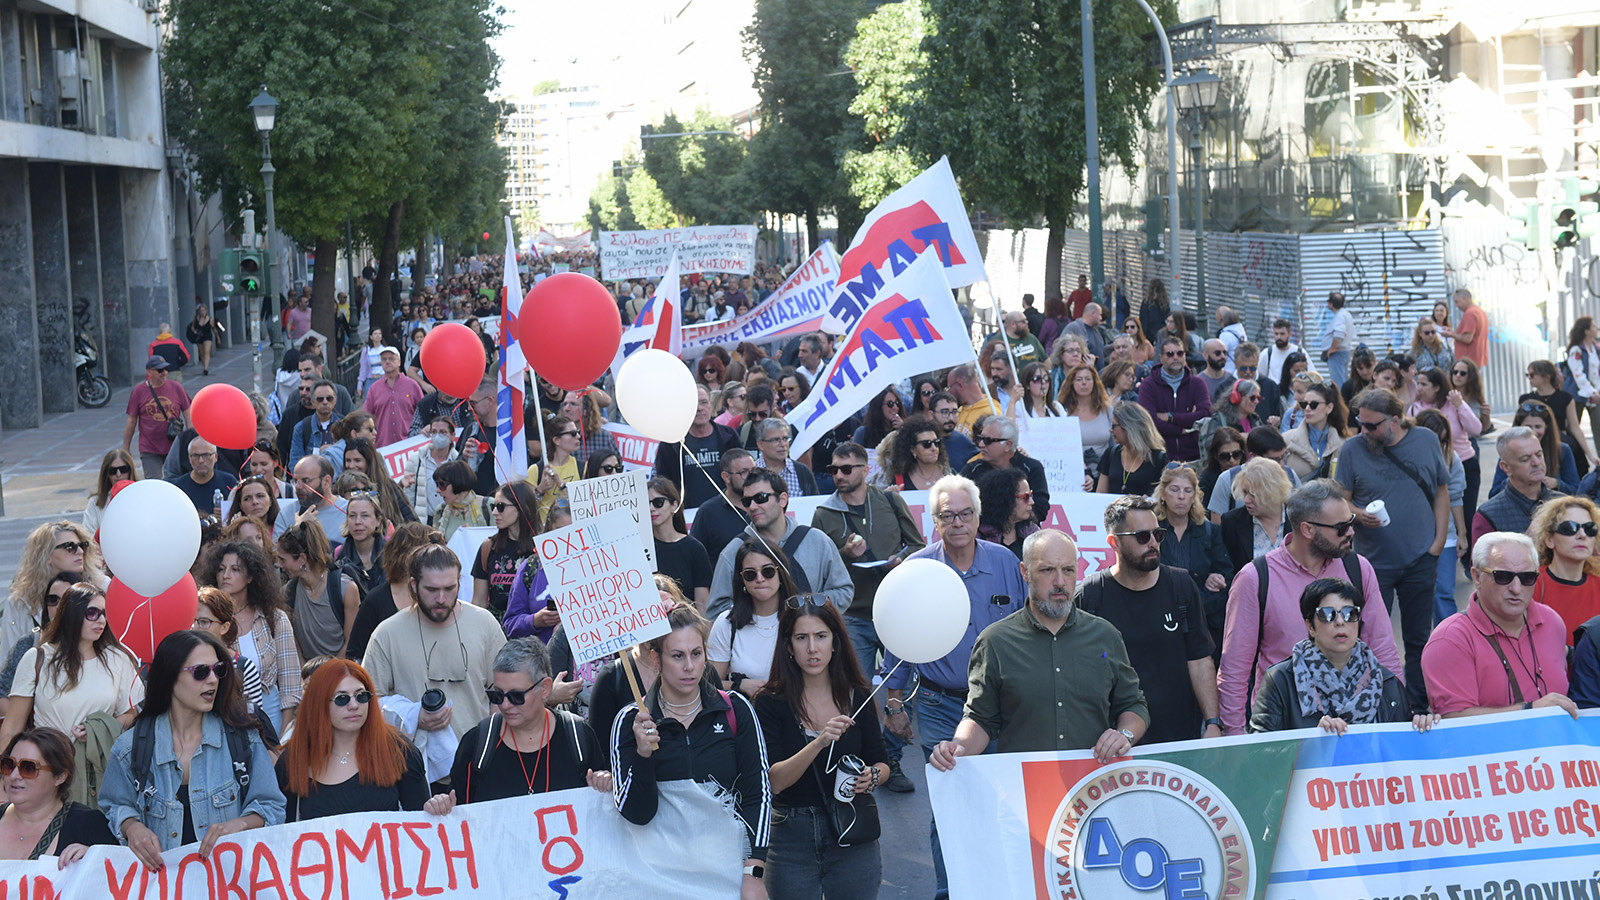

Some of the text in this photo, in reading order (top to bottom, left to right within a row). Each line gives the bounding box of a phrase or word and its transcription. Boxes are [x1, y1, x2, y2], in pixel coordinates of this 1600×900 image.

[555, 544, 619, 586] ΣΤΗΝ
[554, 568, 643, 614] ΚΑΤΗΓΟΡΙΟ
[568, 594, 633, 630] ΠΟΙΗΣΗ
[571, 602, 668, 650] ΤΩΝ ΣΧΟΛΕΙΩΝ
[1087, 770, 1230, 832] ΟΜΟΣΠΟΝΔΙΑ
[1306, 772, 1416, 812] Φτάνει
[1420, 765, 1483, 802] πια!
[1486, 756, 1555, 796] Εδώ
[1083, 817, 1208, 900] ΔΟΕ
[1312, 825, 1361, 862] για
[1365, 822, 1405, 853] να
[1409, 810, 1503, 849] ζούμε
[1507, 808, 1550, 844] με
